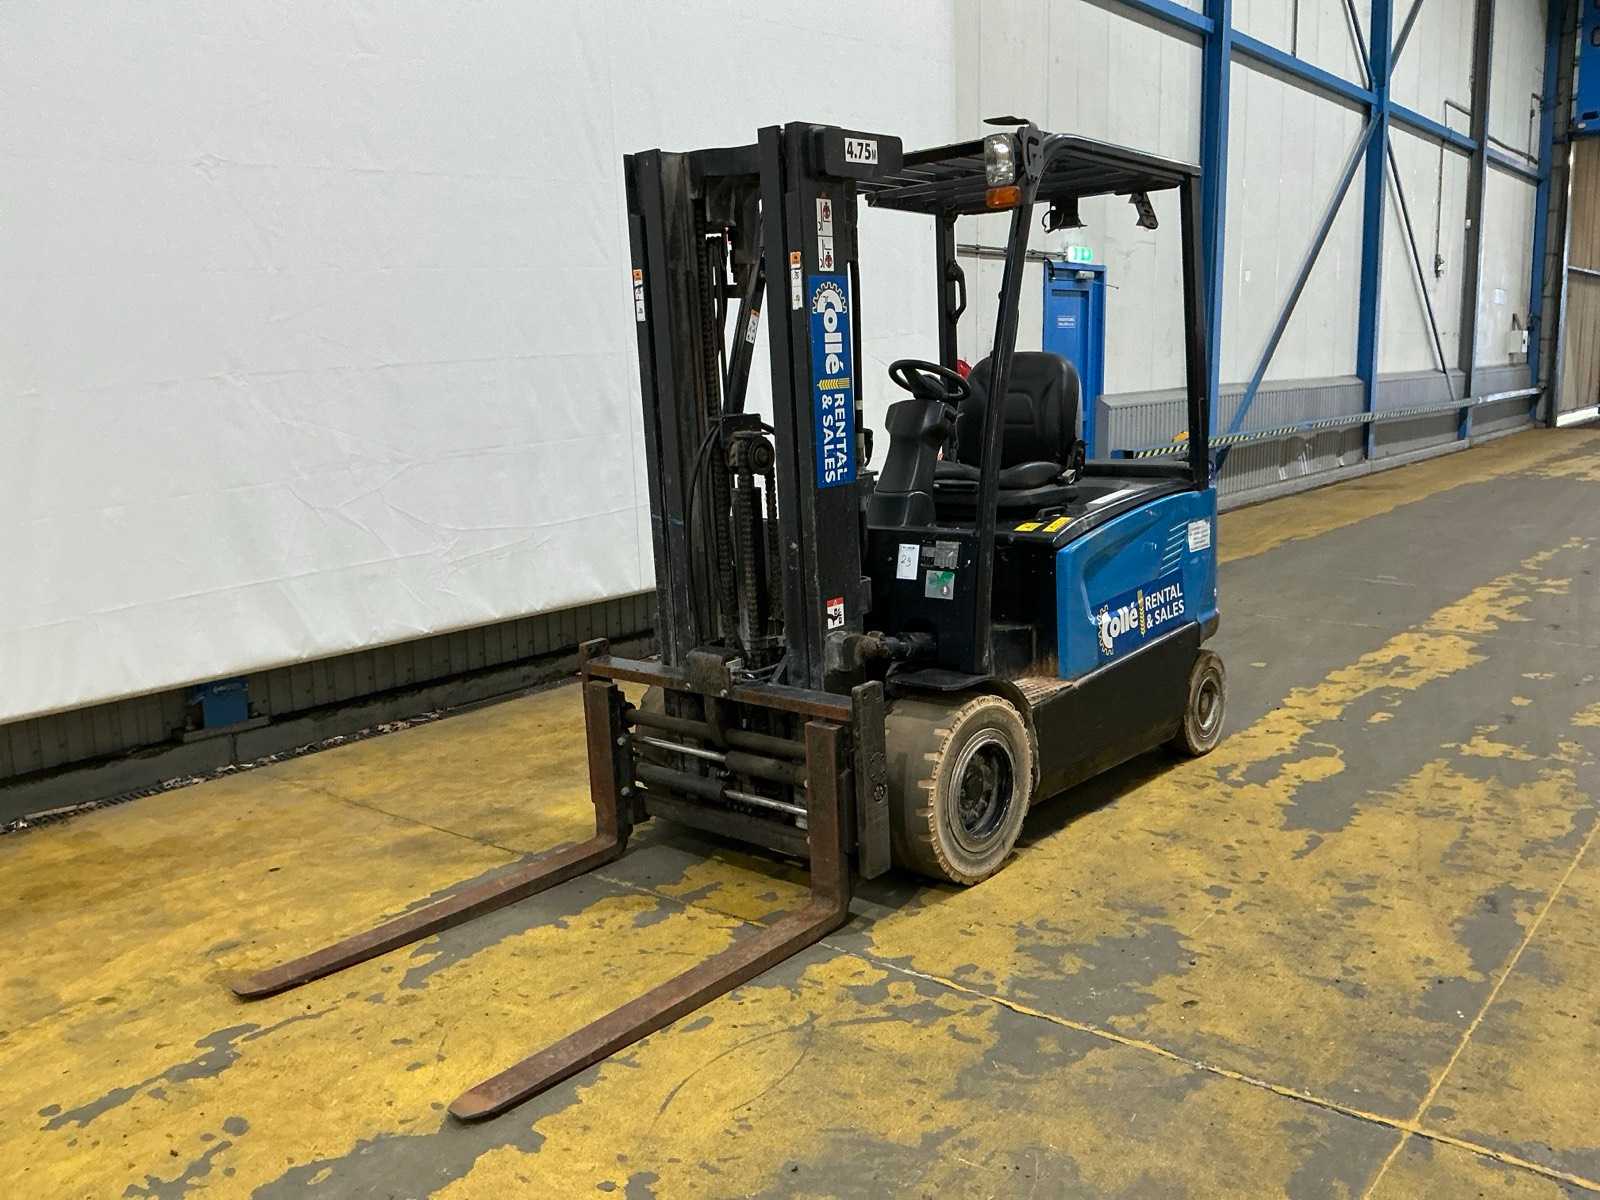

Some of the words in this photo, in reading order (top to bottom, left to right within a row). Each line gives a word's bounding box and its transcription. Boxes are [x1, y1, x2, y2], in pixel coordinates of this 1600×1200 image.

[815, 286, 846, 375] Collé
[821, 394, 833, 410] &
[823, 414, 836, 483] SALES
[834, 393, 848, 481] RENTAL
[1144, 582, 1184, 611] RENTAL
[1146, 613, 1154, 629] &
[1154, 599, 1185, 625] SALES
[1099, 601, 1139, 652] Collé
